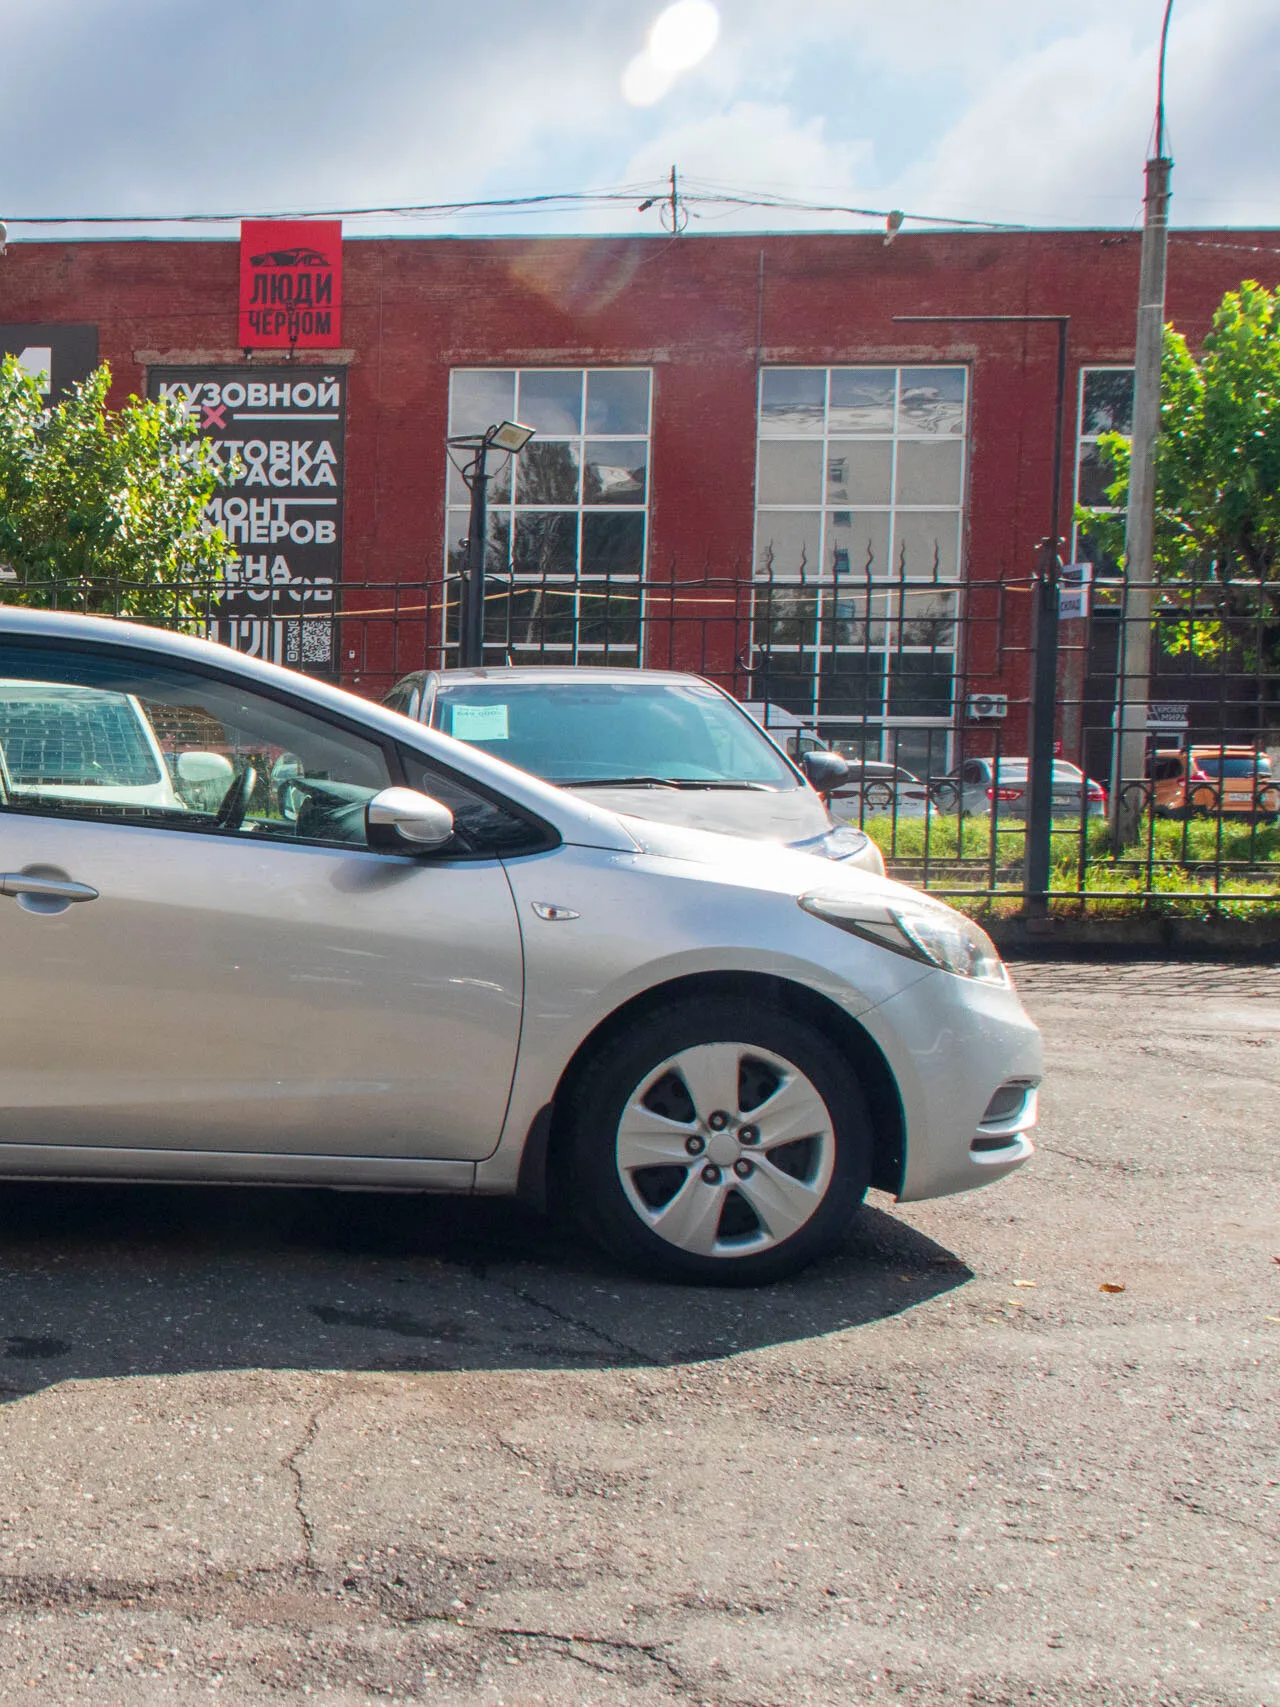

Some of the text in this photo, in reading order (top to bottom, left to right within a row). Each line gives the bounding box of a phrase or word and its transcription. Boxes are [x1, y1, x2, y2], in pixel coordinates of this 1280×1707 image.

[249, 273, 332, 308] ЛЮДИ
[159, 376, 340, 408] КУЗОВНОЙ
[165, 404, 227, 430] ЕХ
[196, 498, 286, 522] МОНТ
